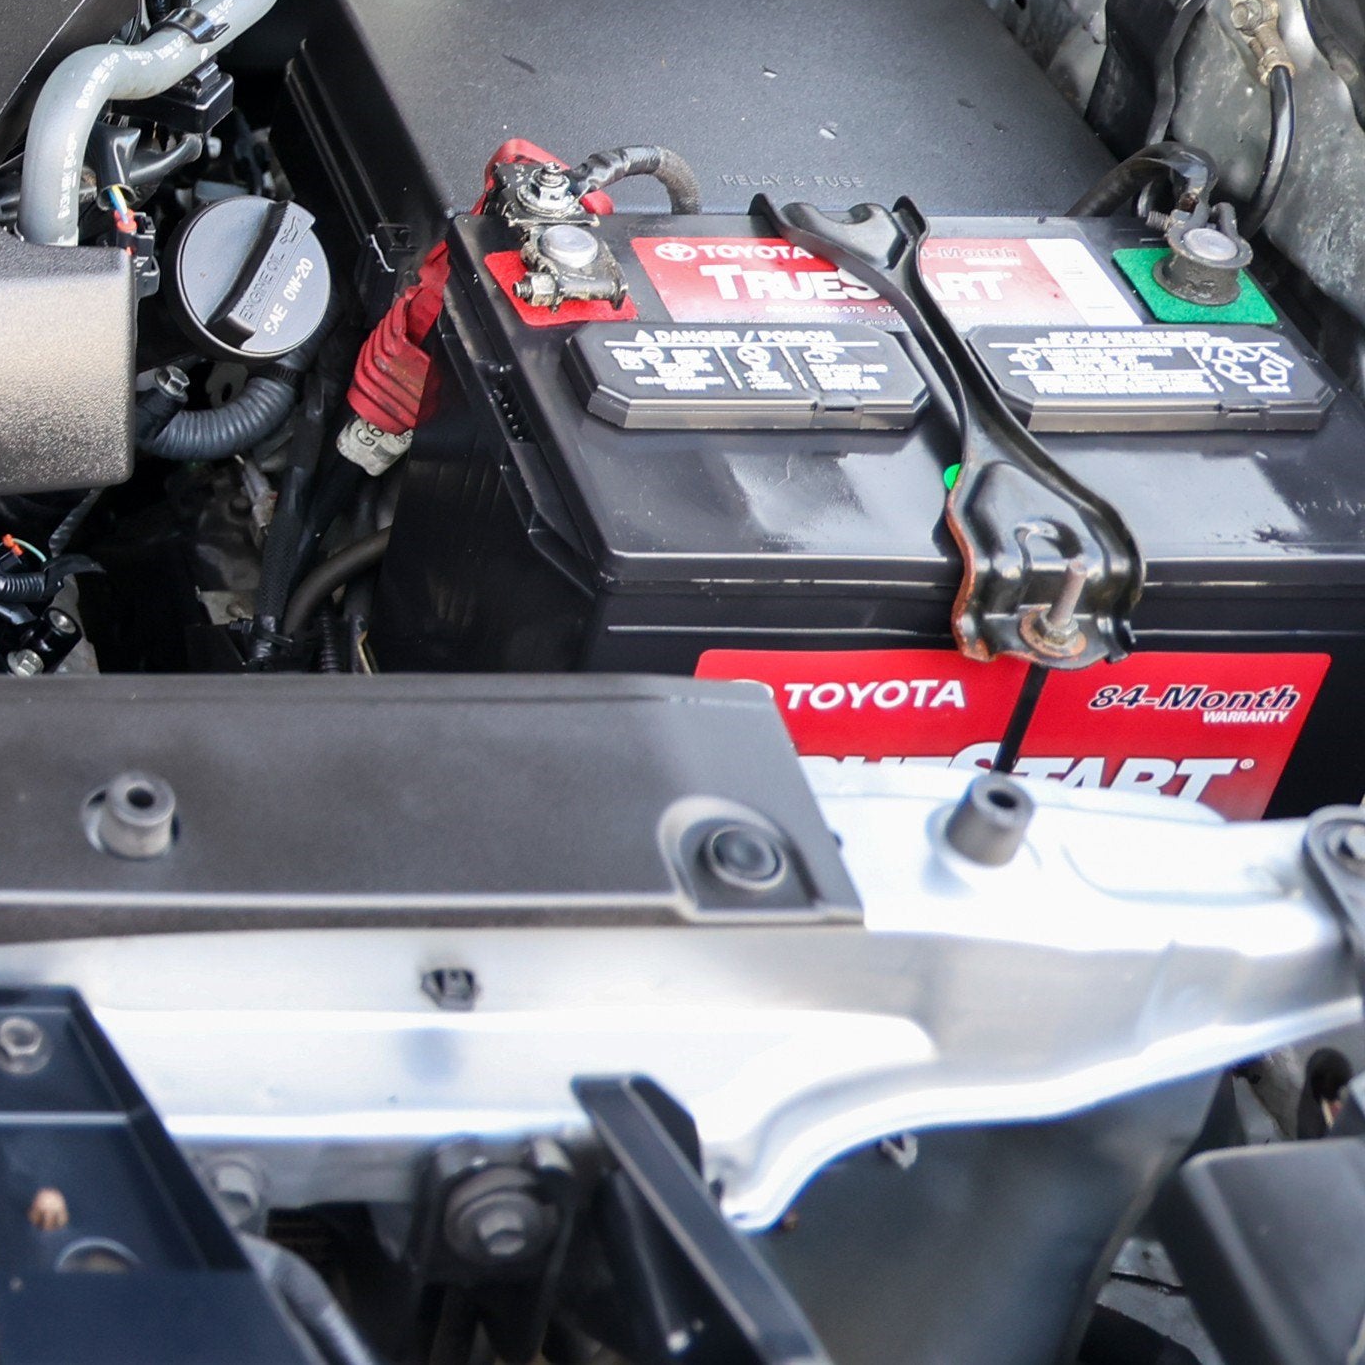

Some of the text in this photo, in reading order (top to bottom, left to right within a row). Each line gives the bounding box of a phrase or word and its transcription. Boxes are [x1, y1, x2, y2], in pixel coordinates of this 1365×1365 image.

[719, 174, 782, 186] RELAY
[814, 176, 864, 188] FUSE
[698, 244, 815, 260] TOYOTA
[263, 257, 315, 335] SAE 0W-20
[653, 330, 743, 343] DANGER
[758, 330, 837, 343] POISON
[783, 679, 966, 710] TOYOTA
[1088, 685, 1300, 710] 84-Month
[1202, 710, 1291, 724] WARRANTY
